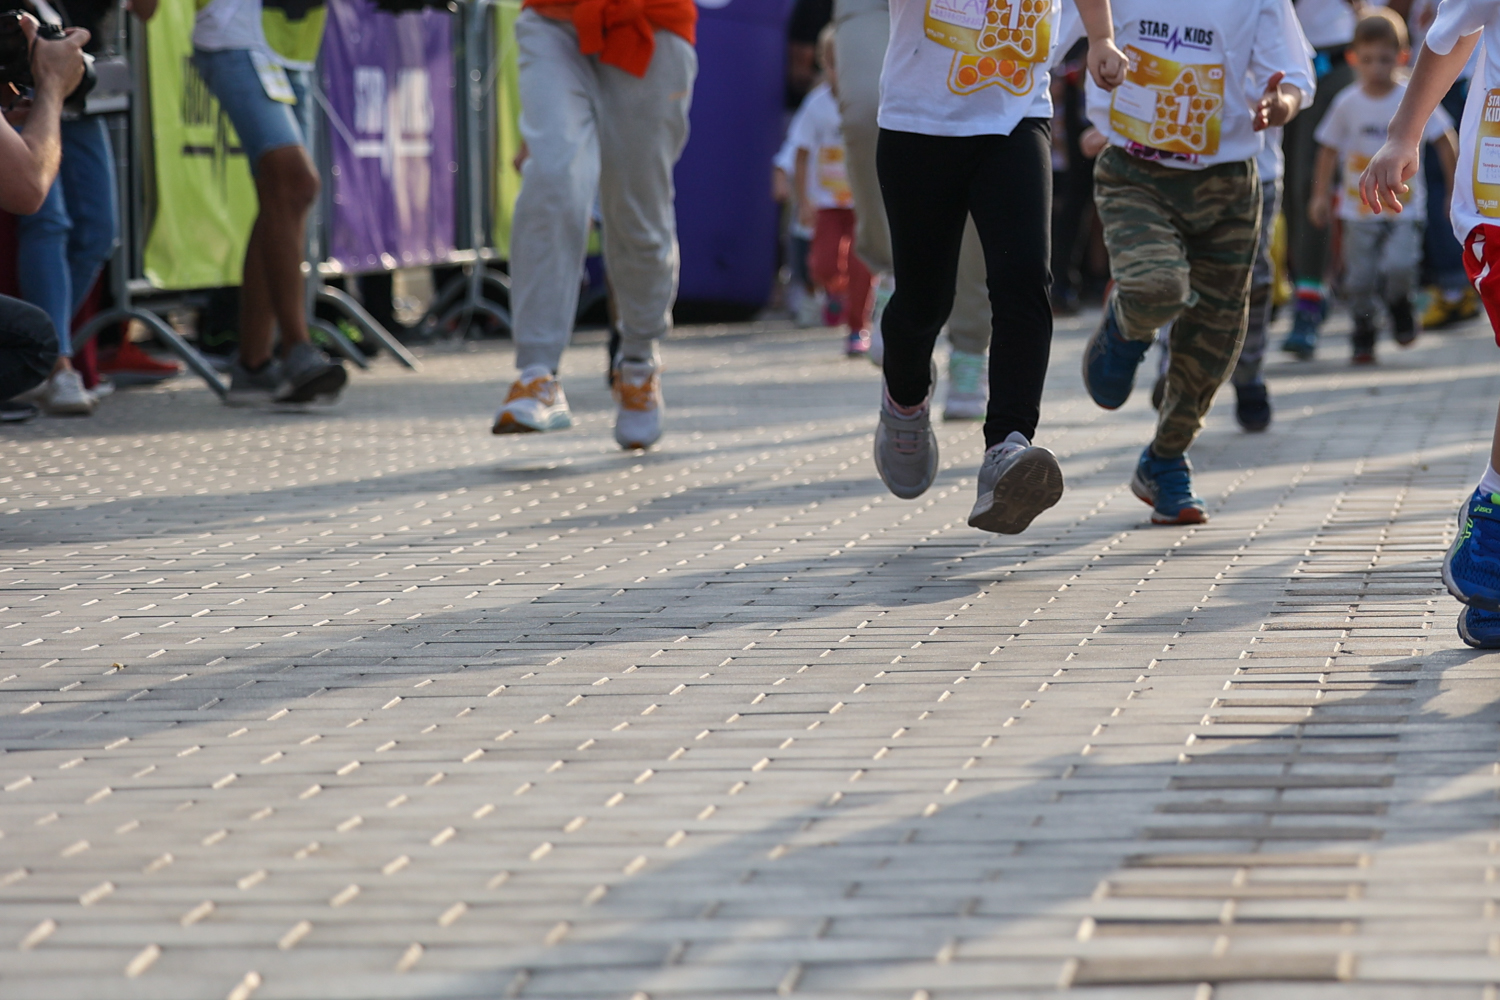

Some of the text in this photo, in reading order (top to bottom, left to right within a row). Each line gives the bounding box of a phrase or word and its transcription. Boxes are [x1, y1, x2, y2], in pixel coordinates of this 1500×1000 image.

[1138, 20, 1214, 45] STAR KIDS
[1174, 96, 1191, 126] 1
